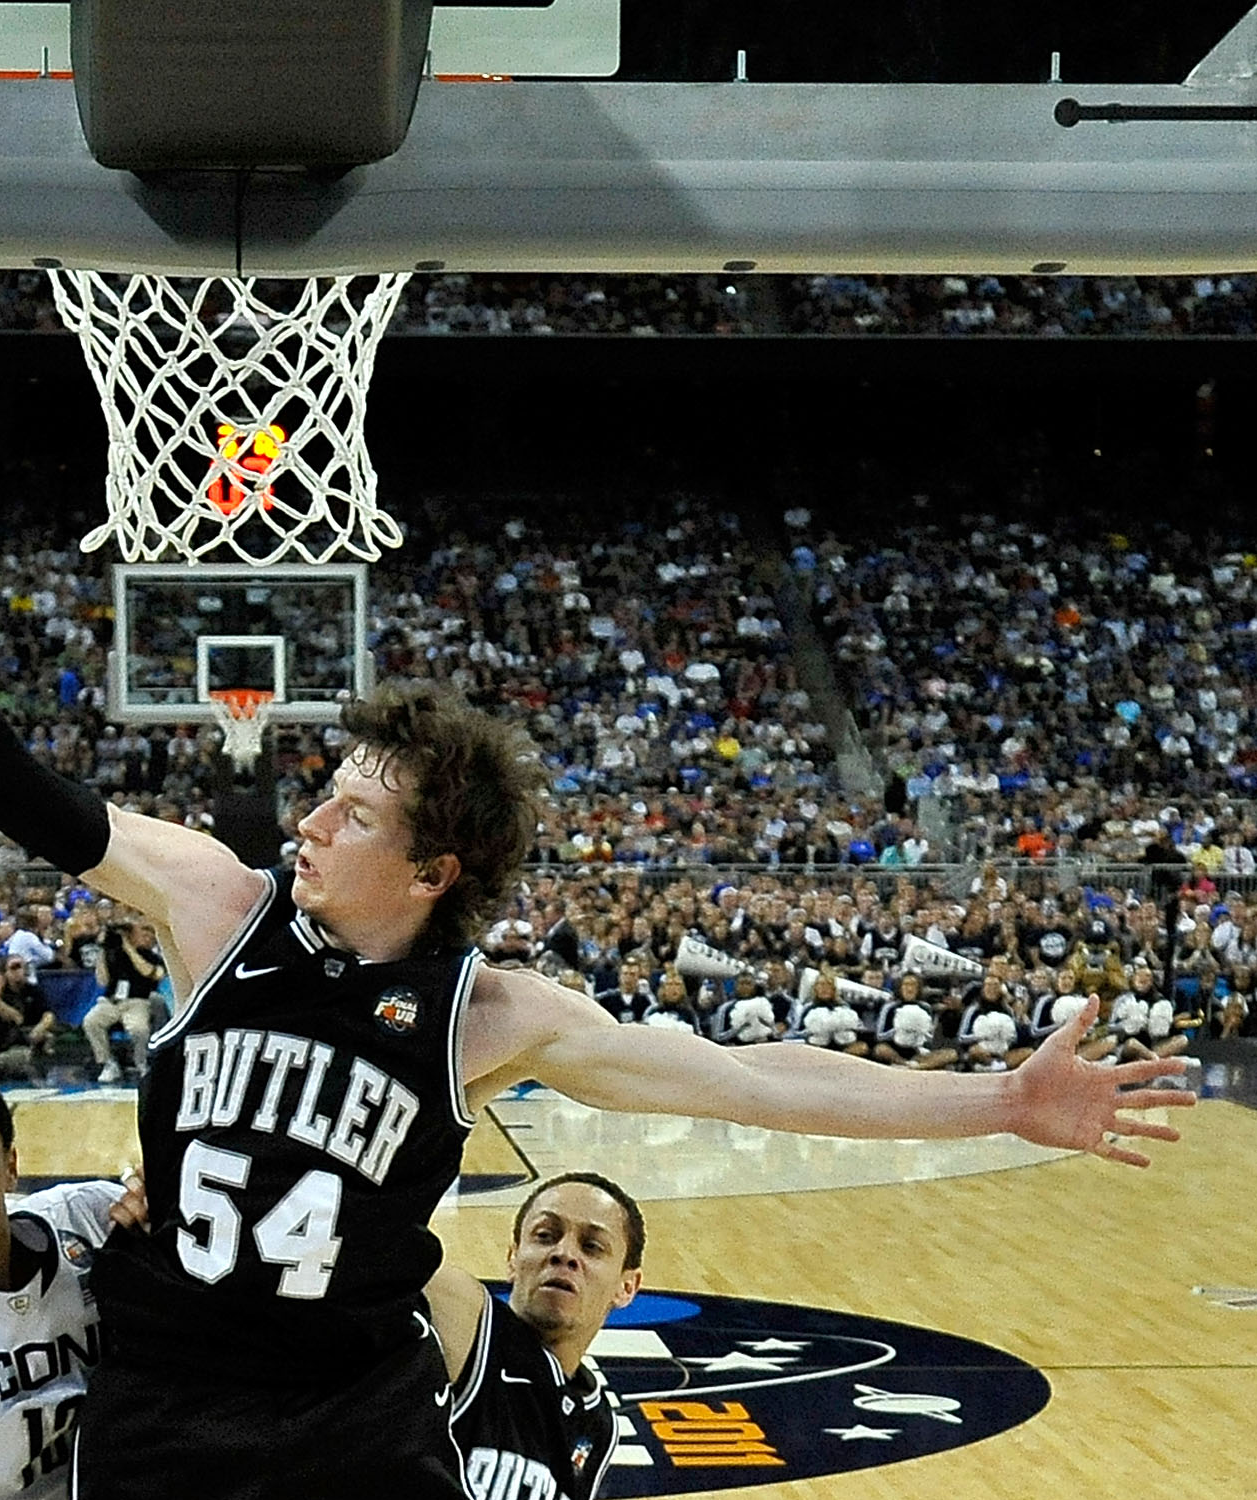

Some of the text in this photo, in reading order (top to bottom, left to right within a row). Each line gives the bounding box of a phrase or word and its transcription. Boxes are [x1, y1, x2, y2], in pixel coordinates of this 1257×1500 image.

[175, 1029, 419, 1186] BUTLER
[177, 1139, 343, 1299] 54
[638, 1401, 786, 1467] 2011
